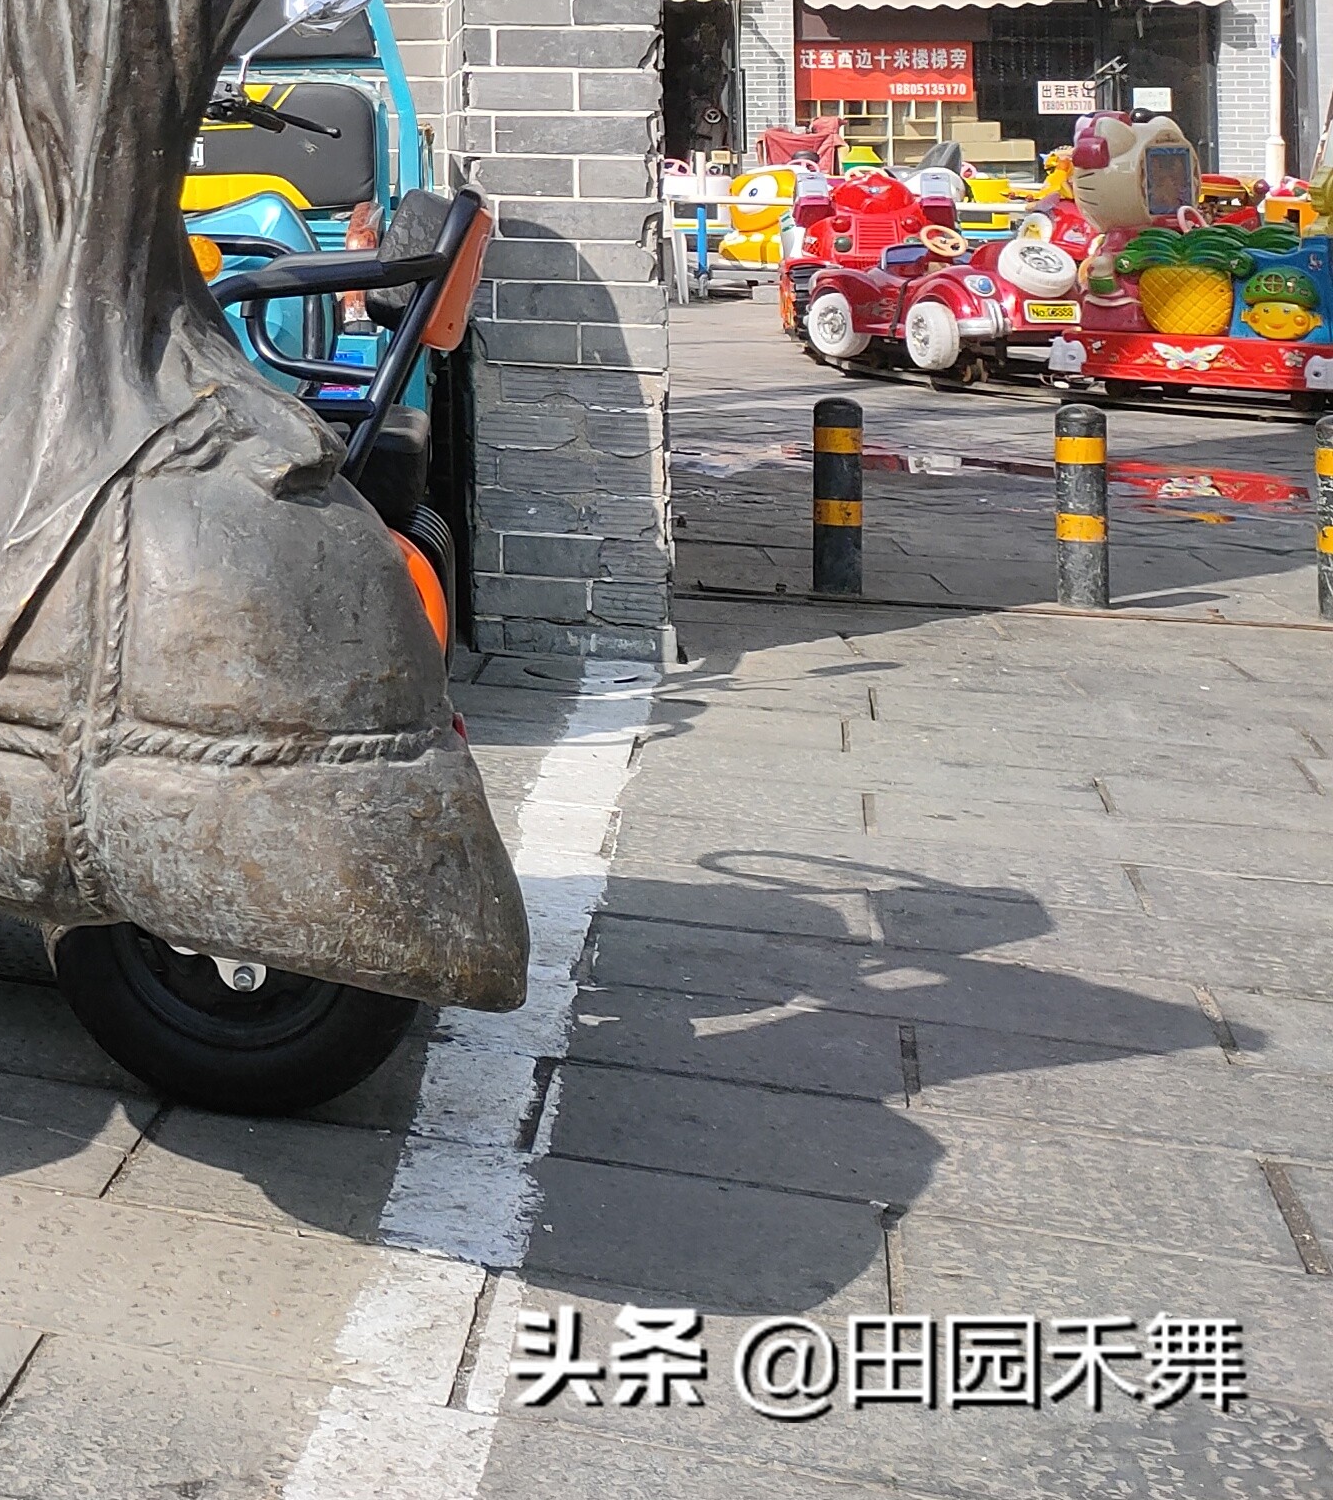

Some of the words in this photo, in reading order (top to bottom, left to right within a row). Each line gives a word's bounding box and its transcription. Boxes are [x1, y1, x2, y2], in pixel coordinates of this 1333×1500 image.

[799, 47, 967, 70] 迁至西边十米楼梯旁
[889, 83, 967, 96] 18805135170
